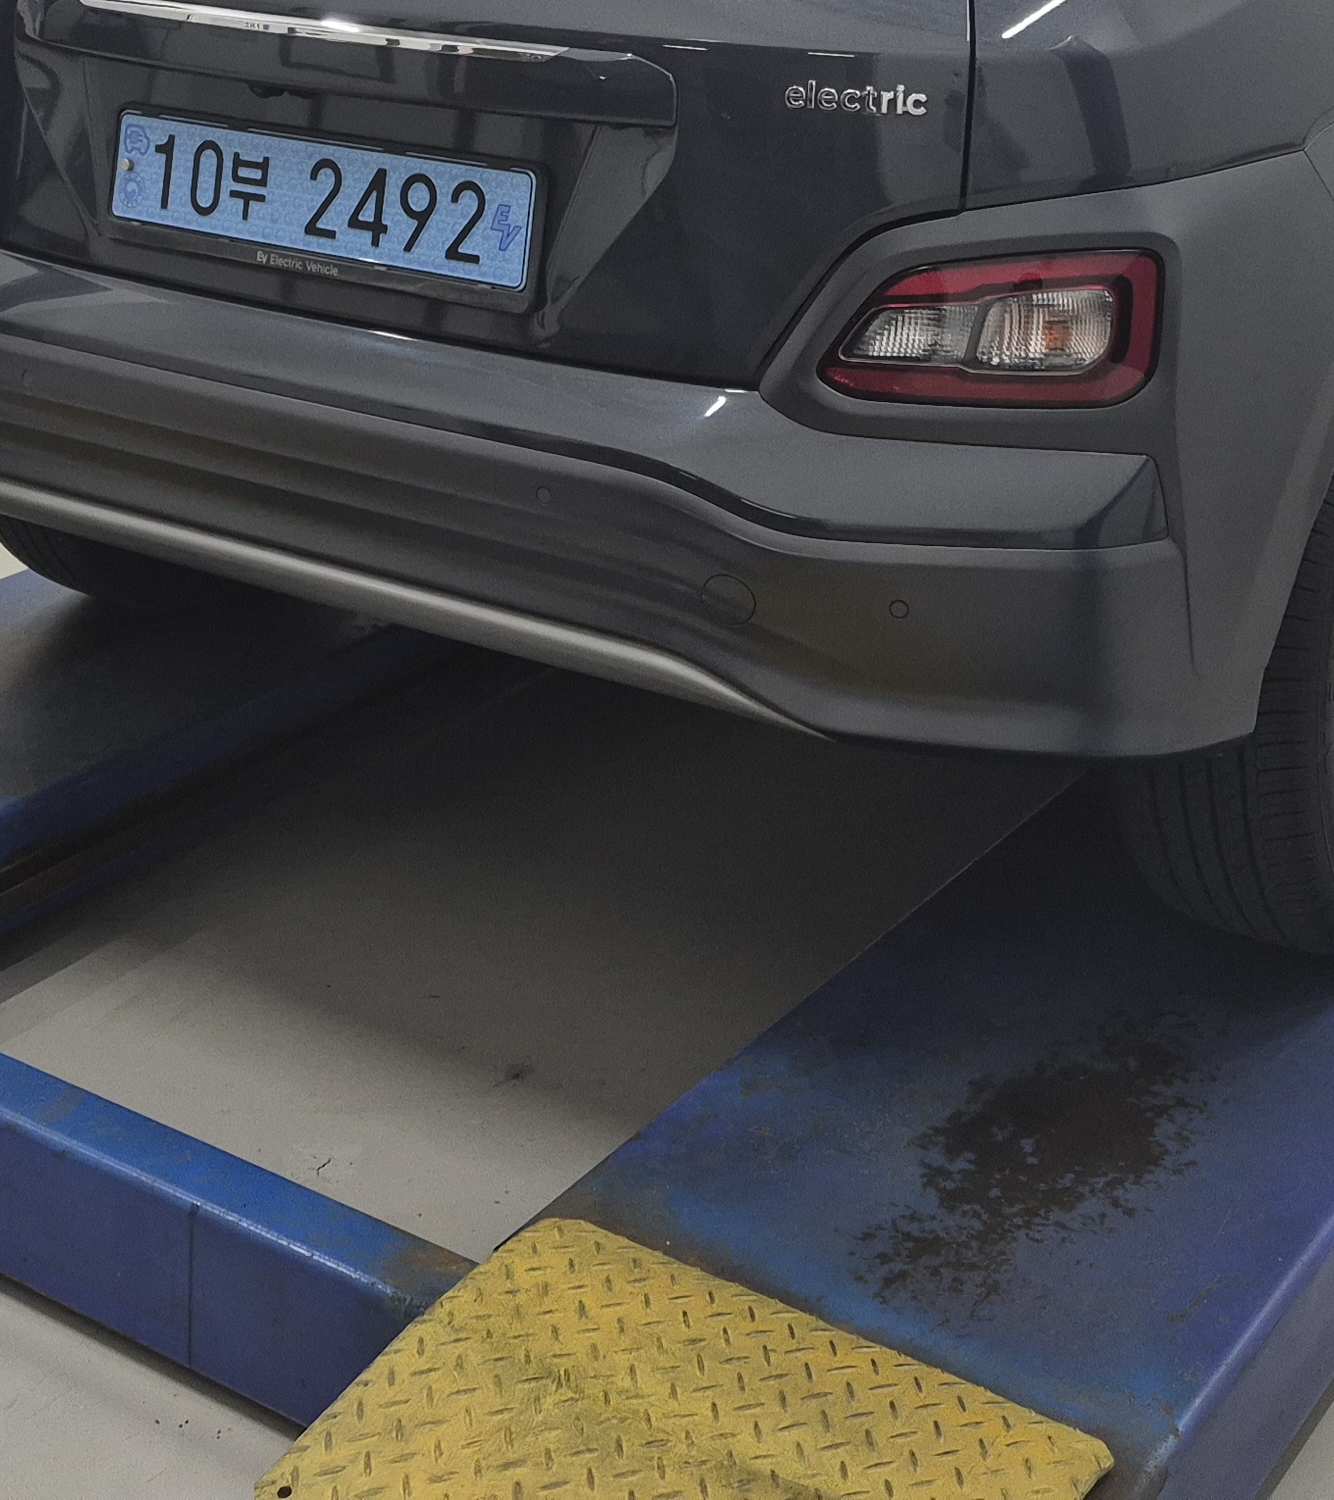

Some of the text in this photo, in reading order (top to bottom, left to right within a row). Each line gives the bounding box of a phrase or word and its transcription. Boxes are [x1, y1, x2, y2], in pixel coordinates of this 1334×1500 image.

[784, 79, 928, 116] electric
[154, 134, 487, 265] 10부 2492
[490, 204, 522, 251] EV
[270, 253, 303, 269] Electric
[306, 260, 339, 276] Vehicle
